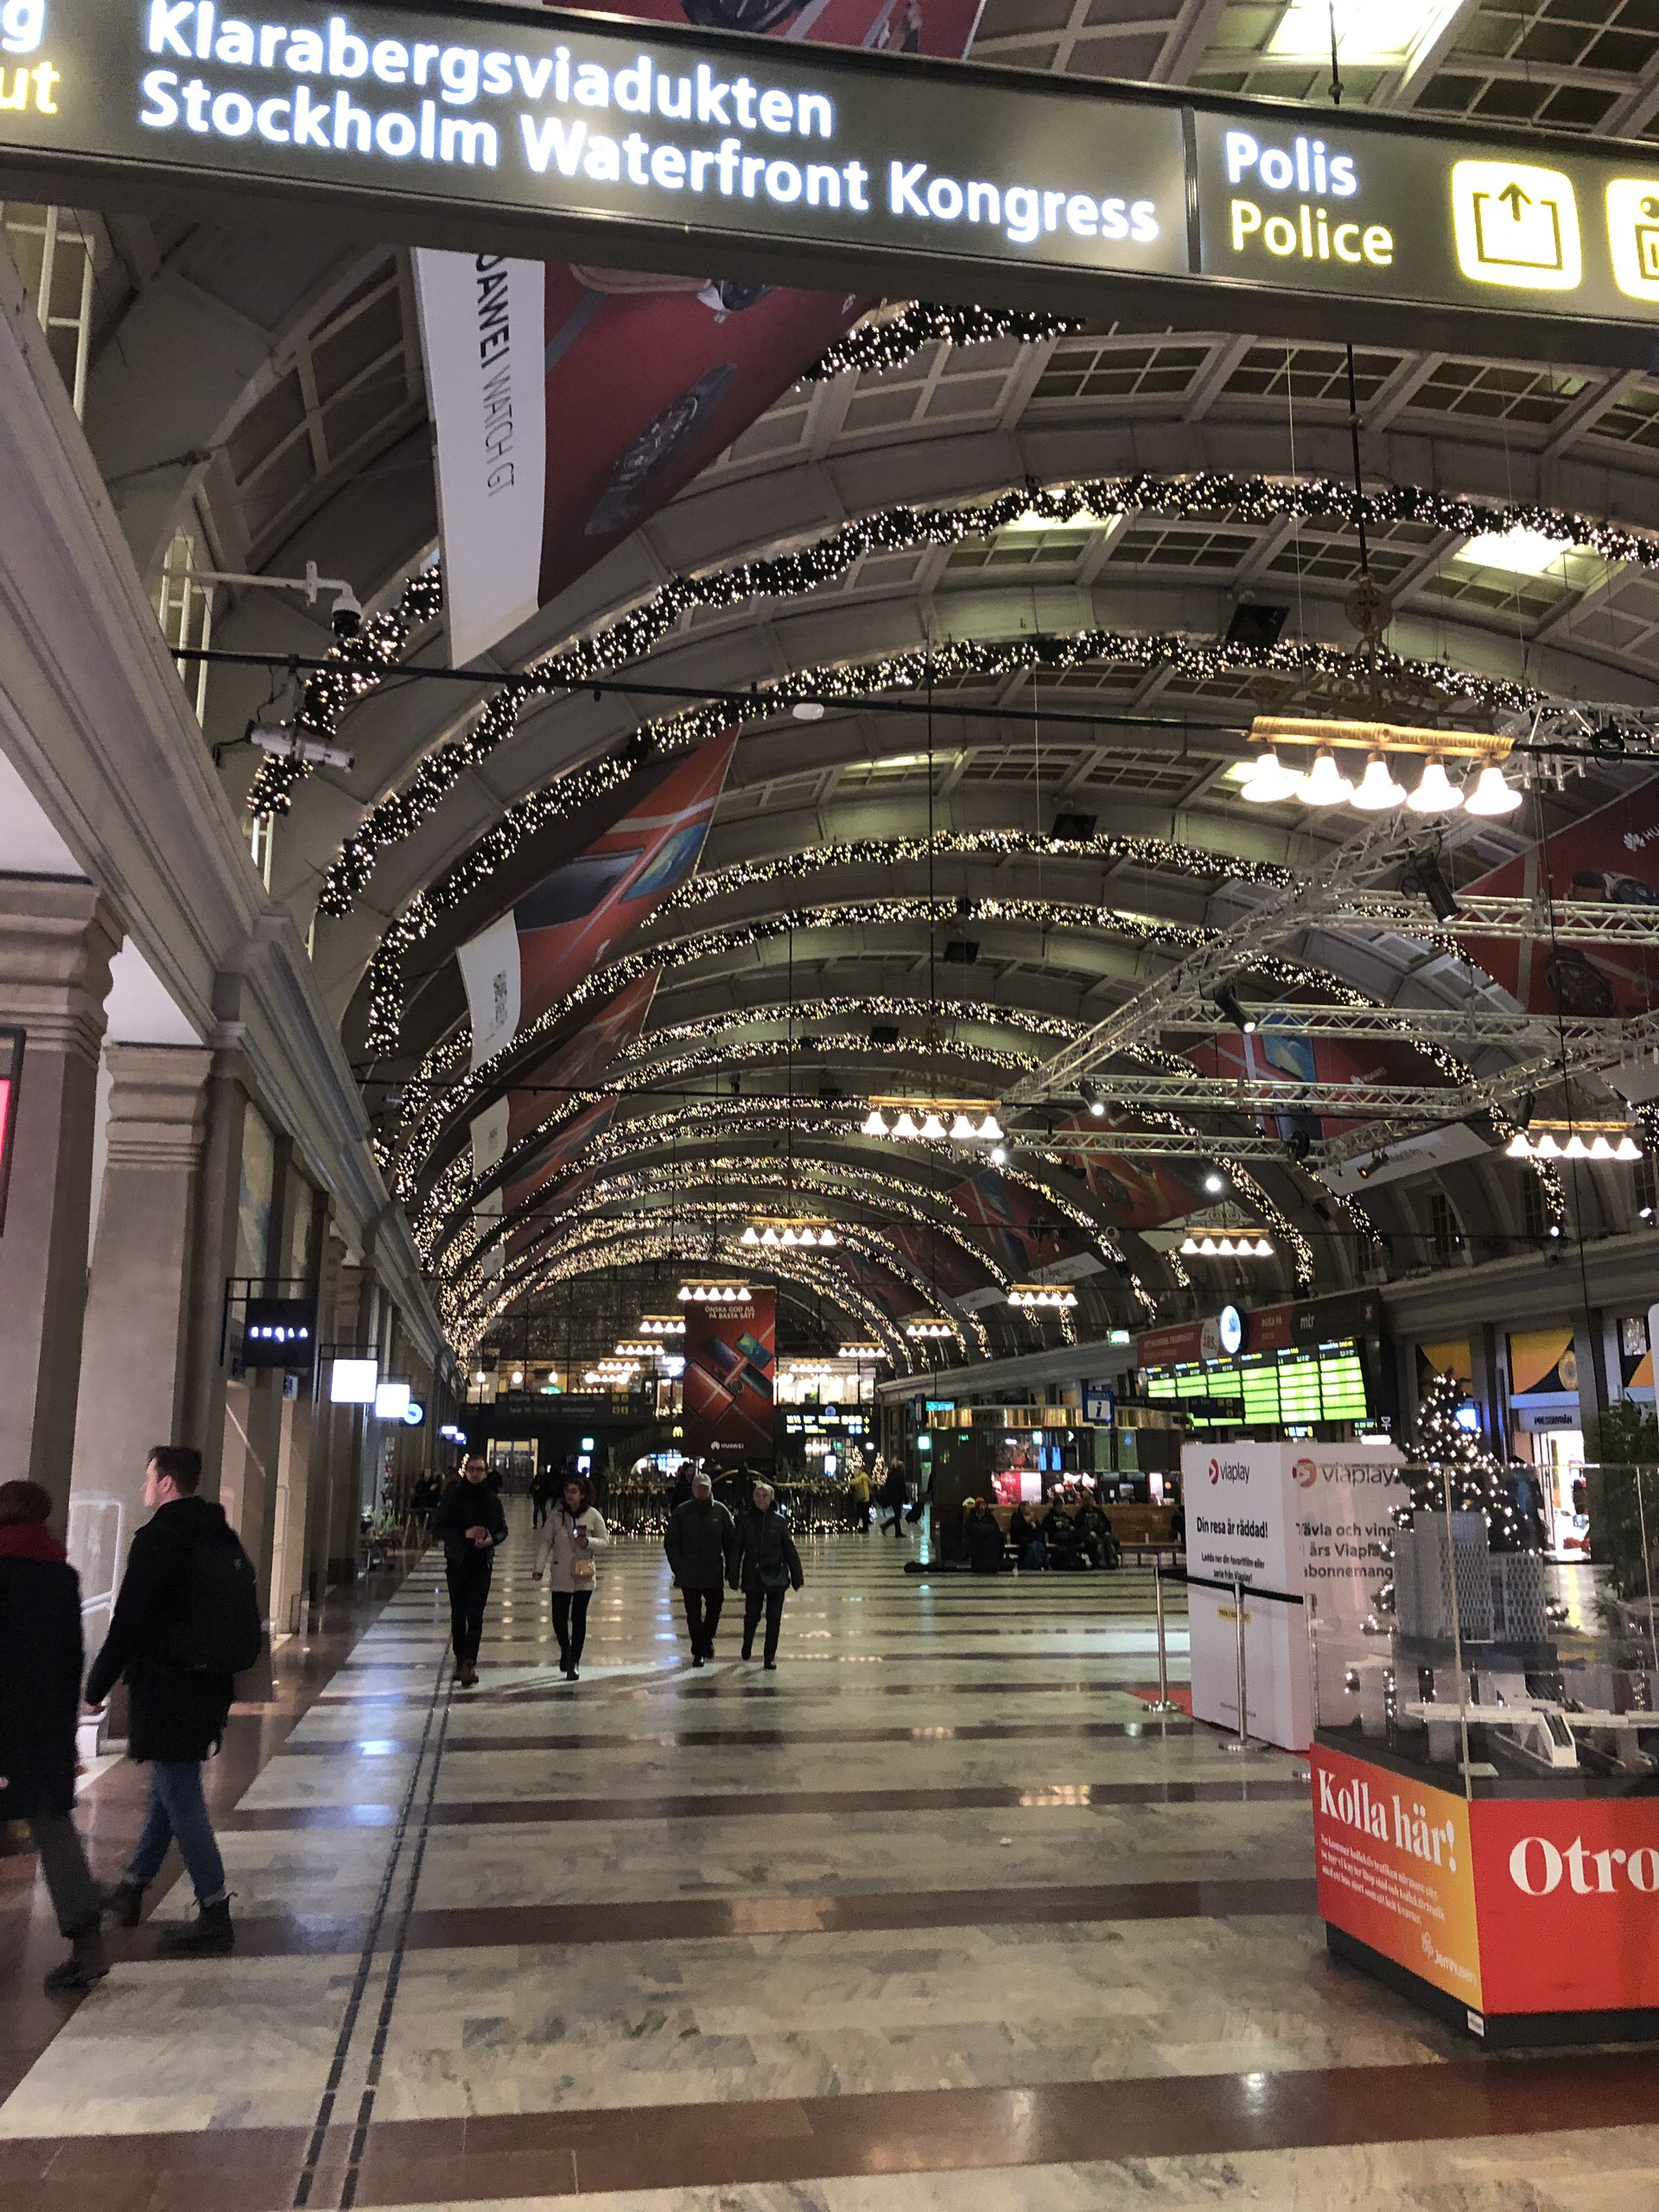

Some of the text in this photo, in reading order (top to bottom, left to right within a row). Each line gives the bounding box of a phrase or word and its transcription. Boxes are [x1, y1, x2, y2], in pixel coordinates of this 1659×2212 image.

[149, 0, 835, 138] Klarabergsviadukten
[140, 69, 1160, 244] Stockholm Waterfront Kongress
[1224, 130, 1358, 198] Polis
[1230, 197, 1396, 268] Police
[483, 365, 514, 465] WATCH
[487, 461, 516, 498] GT
[1220, 1461, 1250, 1484] viaplay
[1197, 1516, 1268, 1539] Din resa är räddad!
[1201, 1552, 1214, 1562] Ladda
[1309, 1541, 1332, 1557] års
[1336, 1522, 1362, 1537] och
[1318, 1768, 1457, 1874] Kolla här!
[1509, 1834, 1659, 1897] Otro
